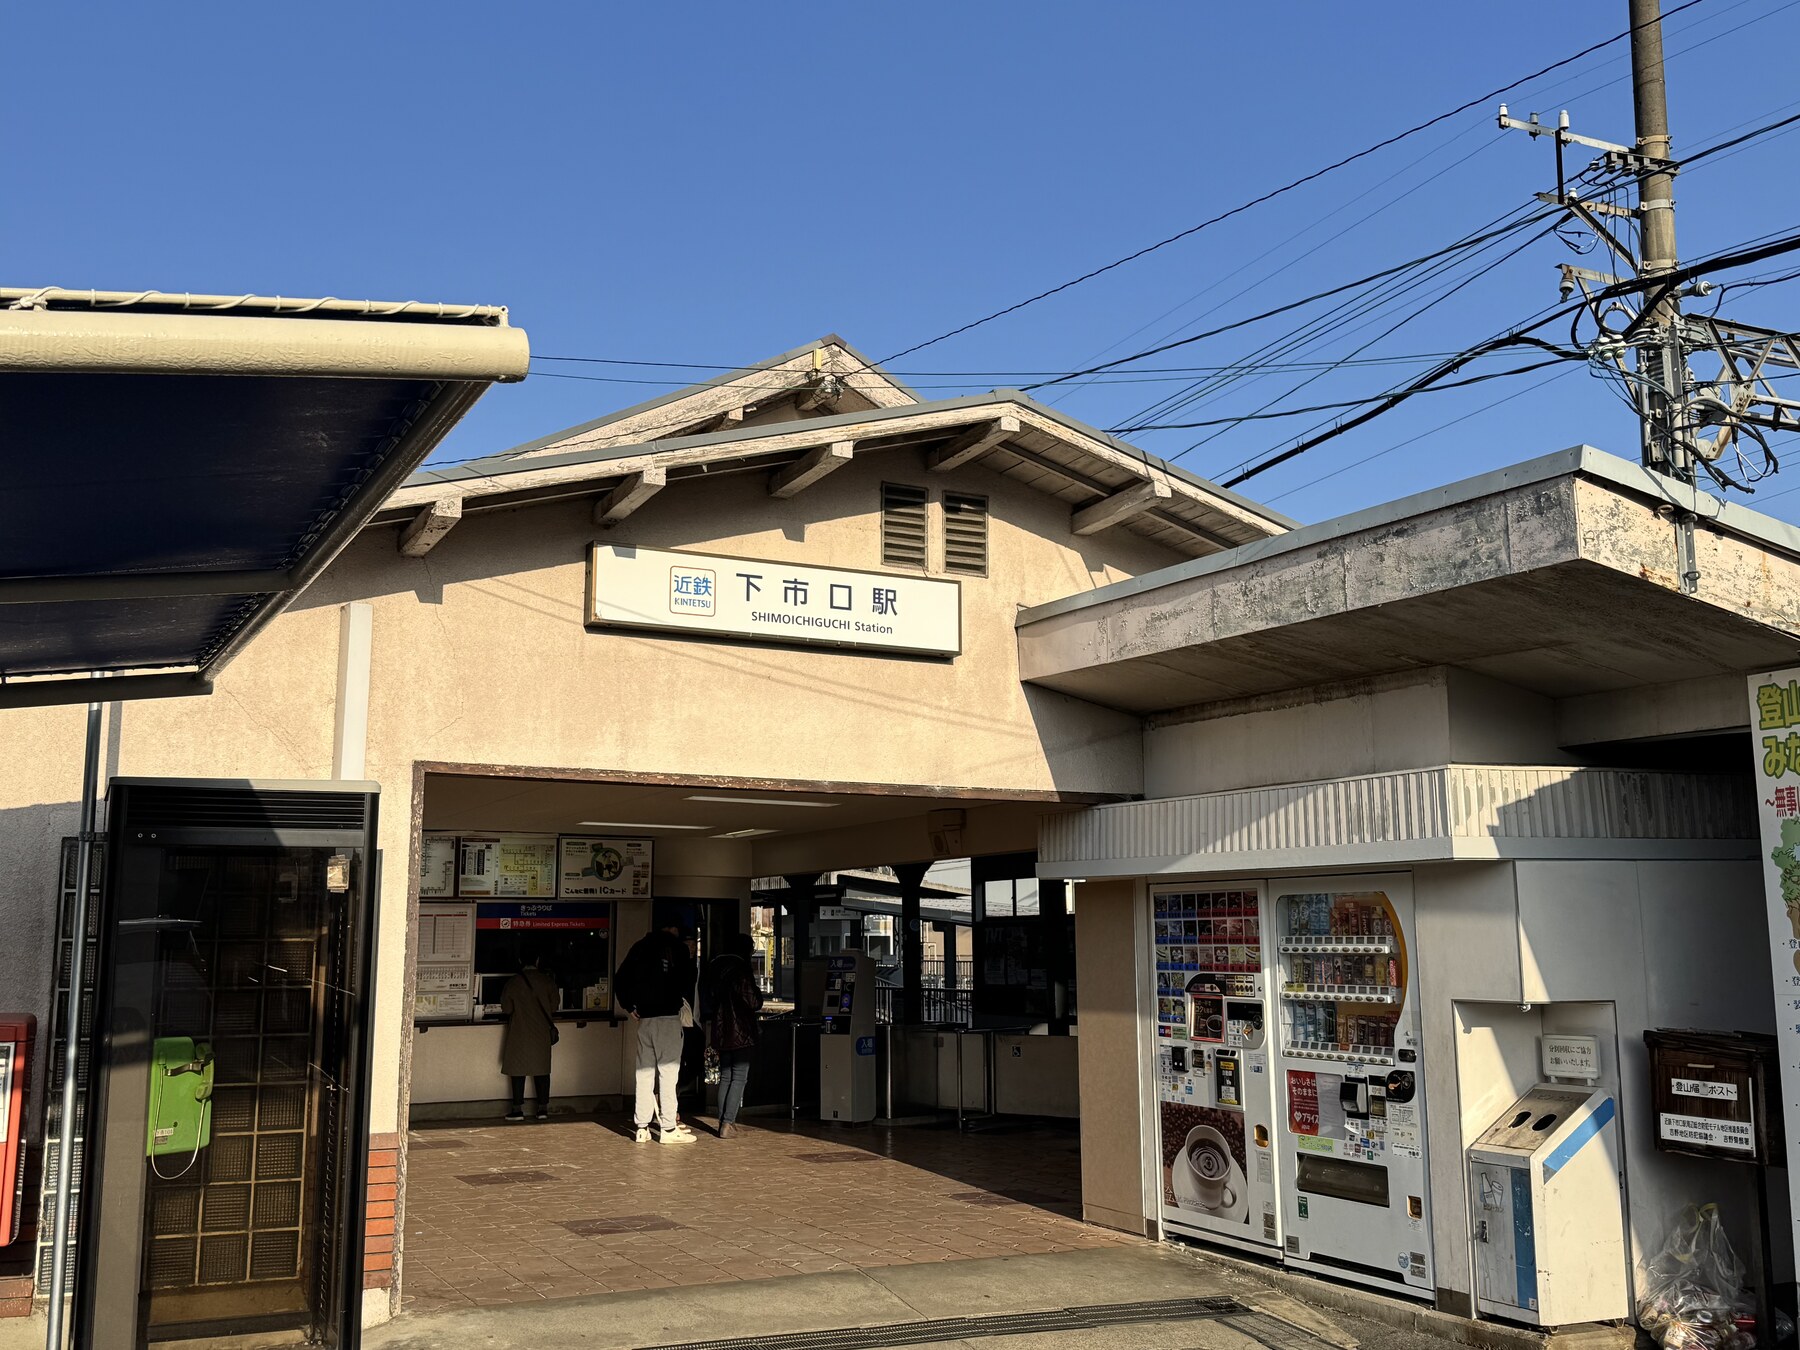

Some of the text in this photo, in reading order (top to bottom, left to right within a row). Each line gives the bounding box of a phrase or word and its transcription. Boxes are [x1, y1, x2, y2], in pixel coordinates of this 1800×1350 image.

[673, 575, 713, 597] 近鉄
[735, 572, 898, 616] 下市口駅
[674, 597, 712, 609] KINTETSU
[751, 611, 893, 635] SHIMOICHIGUCHI Station
